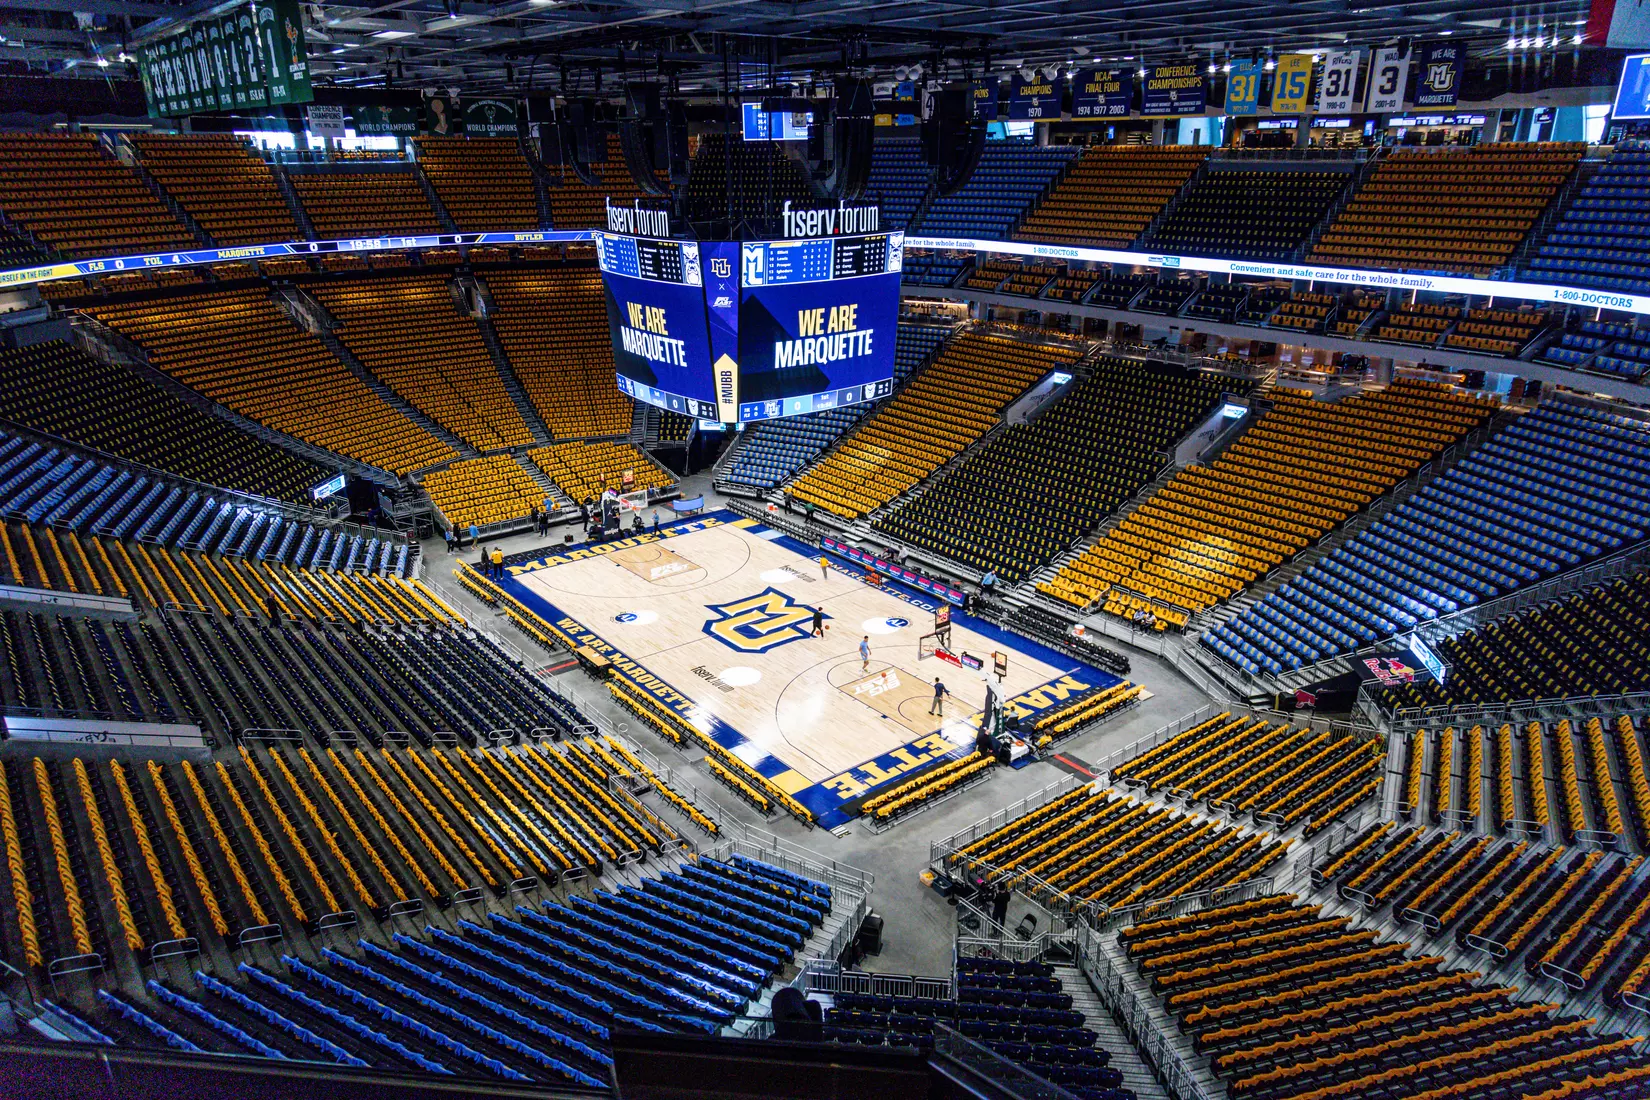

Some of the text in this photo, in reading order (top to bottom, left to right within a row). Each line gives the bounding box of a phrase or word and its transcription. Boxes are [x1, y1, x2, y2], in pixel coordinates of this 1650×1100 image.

[231, 40, 242, 85] 4
[244, 36, 258, 82] 2
[267, 28, 280, 78] 1
[1290, 59, 1300, 68] LEE
[1432, 49, 1456, 59] WE ARE
[214, 44, 226, 88] 8
[1094, 72, 1112, 82] NCAA
[1156, 65, 1198, 78] CONFERENCE
[1020, 85, 1052, 96] CHAMPIONS
[1086, 82, 1120, 93] FINAL FOUR
[1148, 76, 1202, 90] CHAMPIONSHIPS
[1230, 75, 1256, 102] 31
[1276, 72, 1306, 100] 15
[1325, 68, 1352, 97] 31
[1378, 66, 1400, 95] 3
[1078, 105, 1124, 115] 1974 1977 2003
[1418, 94, 1454, 104] MARQUETTE
[311, 112, 340, 120] CHAMPIONS
[1028, 108, 1042, 117] 1970
[359, 123, 415, 132] WORLD CHAMPIONS
[467, 124, 517, 132] WORLD CHAMPIONS
[217, 233, 544, 258] MARQUETTE 0 19:58 1st 0 BUTLER
[1033, 247, 1078, 257] 1-800-DOCTORS
[88, 254, 180, 271] FLS 0 TOL 4
[20, 272, 26, 280] IN
[27, 271, 36, 279] THE
[38, 268, 52, 277] FIGHT
[1230, 263, 1434, 289] Convenient and safe care for the whole family.
[1554, 289, 1633, 308] 1-800-DOCTORS
[626, 301, 668, 336] WE ARE
[798, 304, 858, 337] WE ARE
[620, 326, 688, 368] MARQUETTE
[774, 328, 874, 369] MARQUETTE
[720, 370, 733, 404] #MUBB
[794, 402, 800, 411] 0
[846, 393, 852, 401] 0
[504, 517, 725, 576] MARQUETTE
[702, 585, 834, 654] MU
[556, 618, 580, 637] WE
[579, 627, 613, 657] ARE
